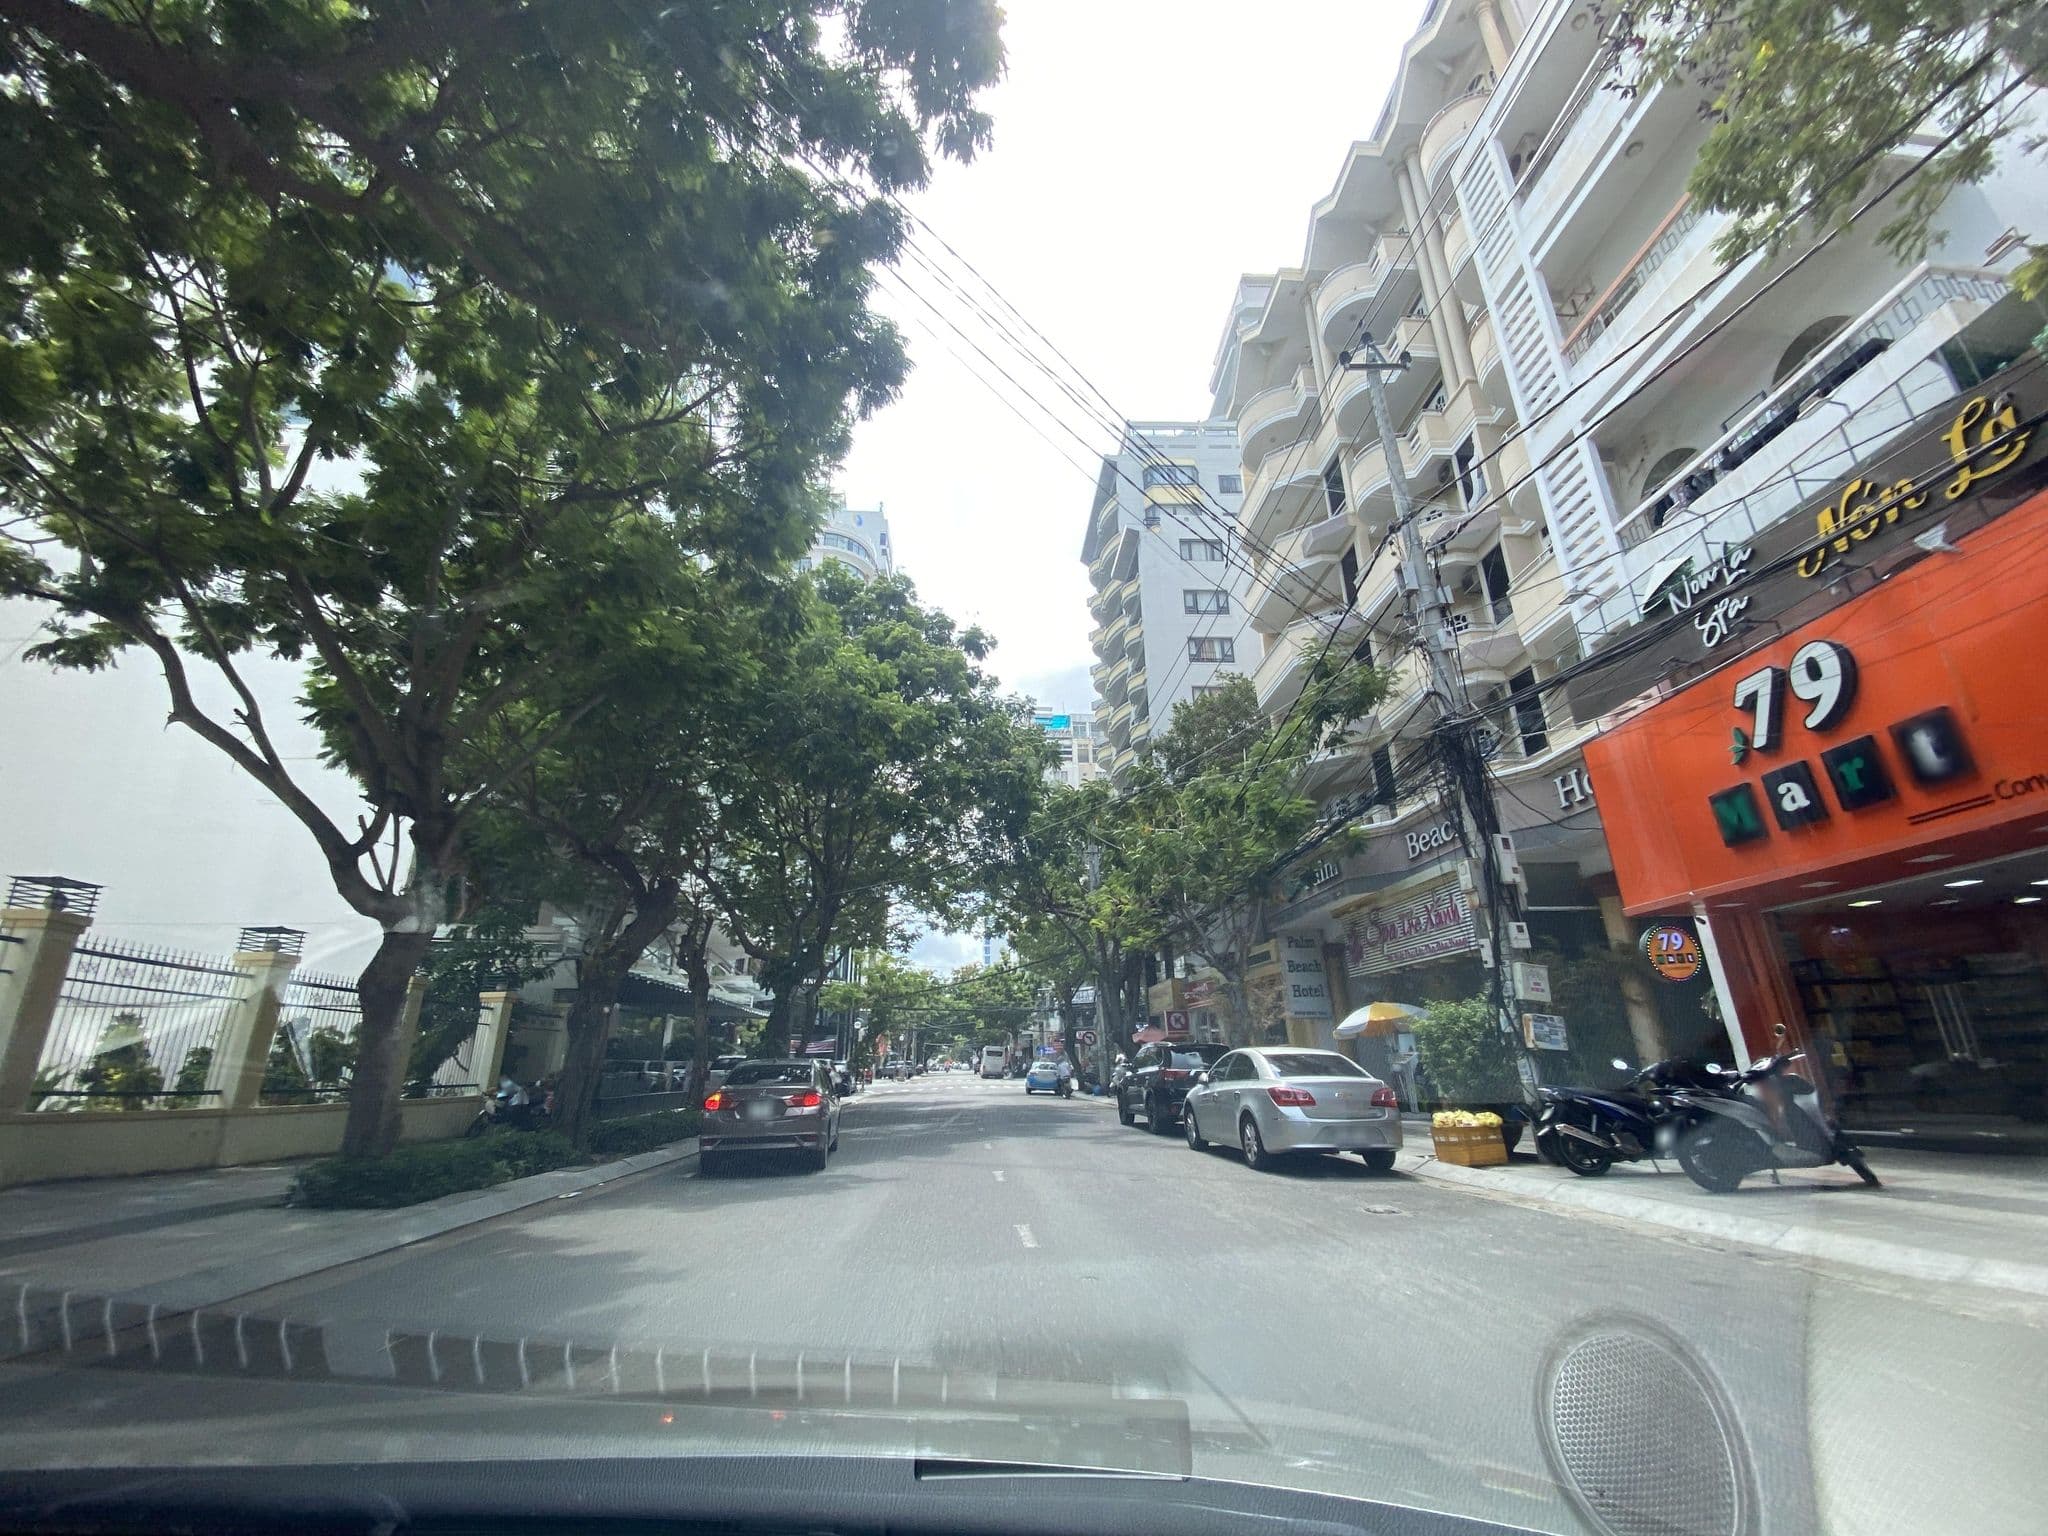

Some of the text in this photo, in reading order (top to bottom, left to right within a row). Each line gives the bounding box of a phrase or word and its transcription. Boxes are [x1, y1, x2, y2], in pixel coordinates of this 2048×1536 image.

[1733, 640, 1850, 751] 79
[1710, 714, 1965, 837] Mart
[1405, 821, 1458, 859] Beac
[1657, 932, 1684, 951] 79
[1287, 959, 1323, 973] Beach
[1291, 984, 1325, 998] Hotel
